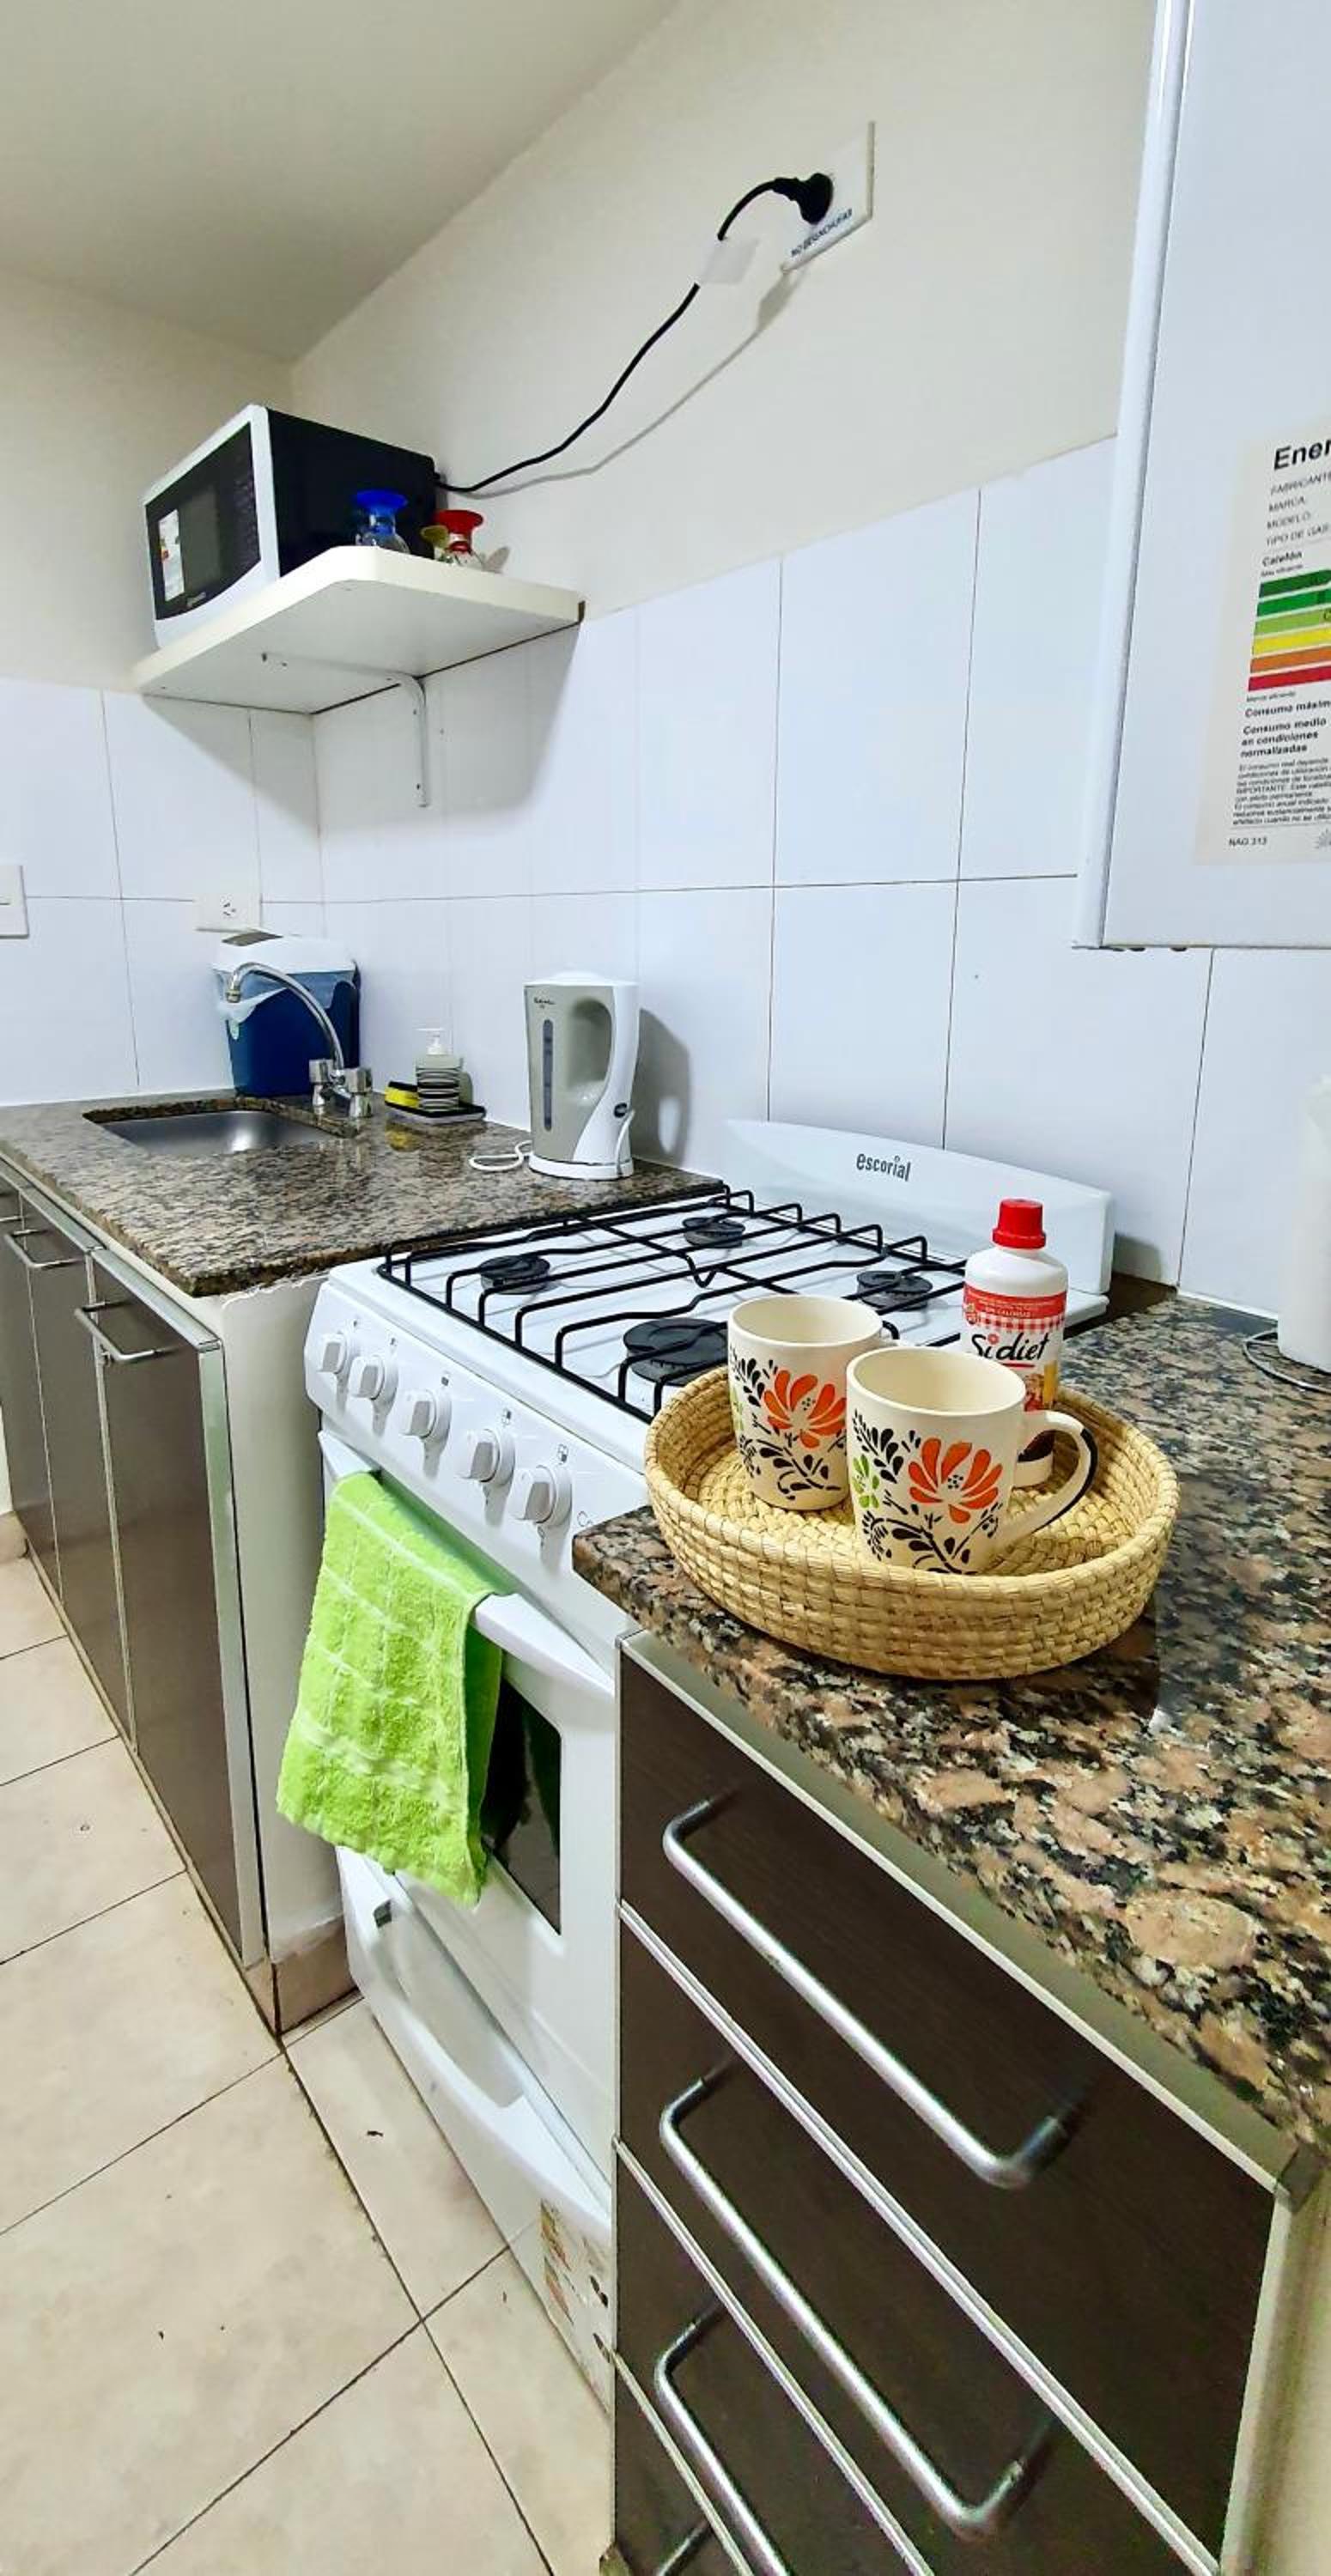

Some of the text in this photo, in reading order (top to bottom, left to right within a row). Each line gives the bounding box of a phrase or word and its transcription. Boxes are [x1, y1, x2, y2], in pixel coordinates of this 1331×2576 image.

[1245, 705, 1292, 718] Consumo
[1243, 717, 1327, 735] Consumo medio
[1256, 731, 1318, 744] condiciones
[1241, 744, 1307, 757] normalizadas
[856, 1153, 911, 1182] escorial
